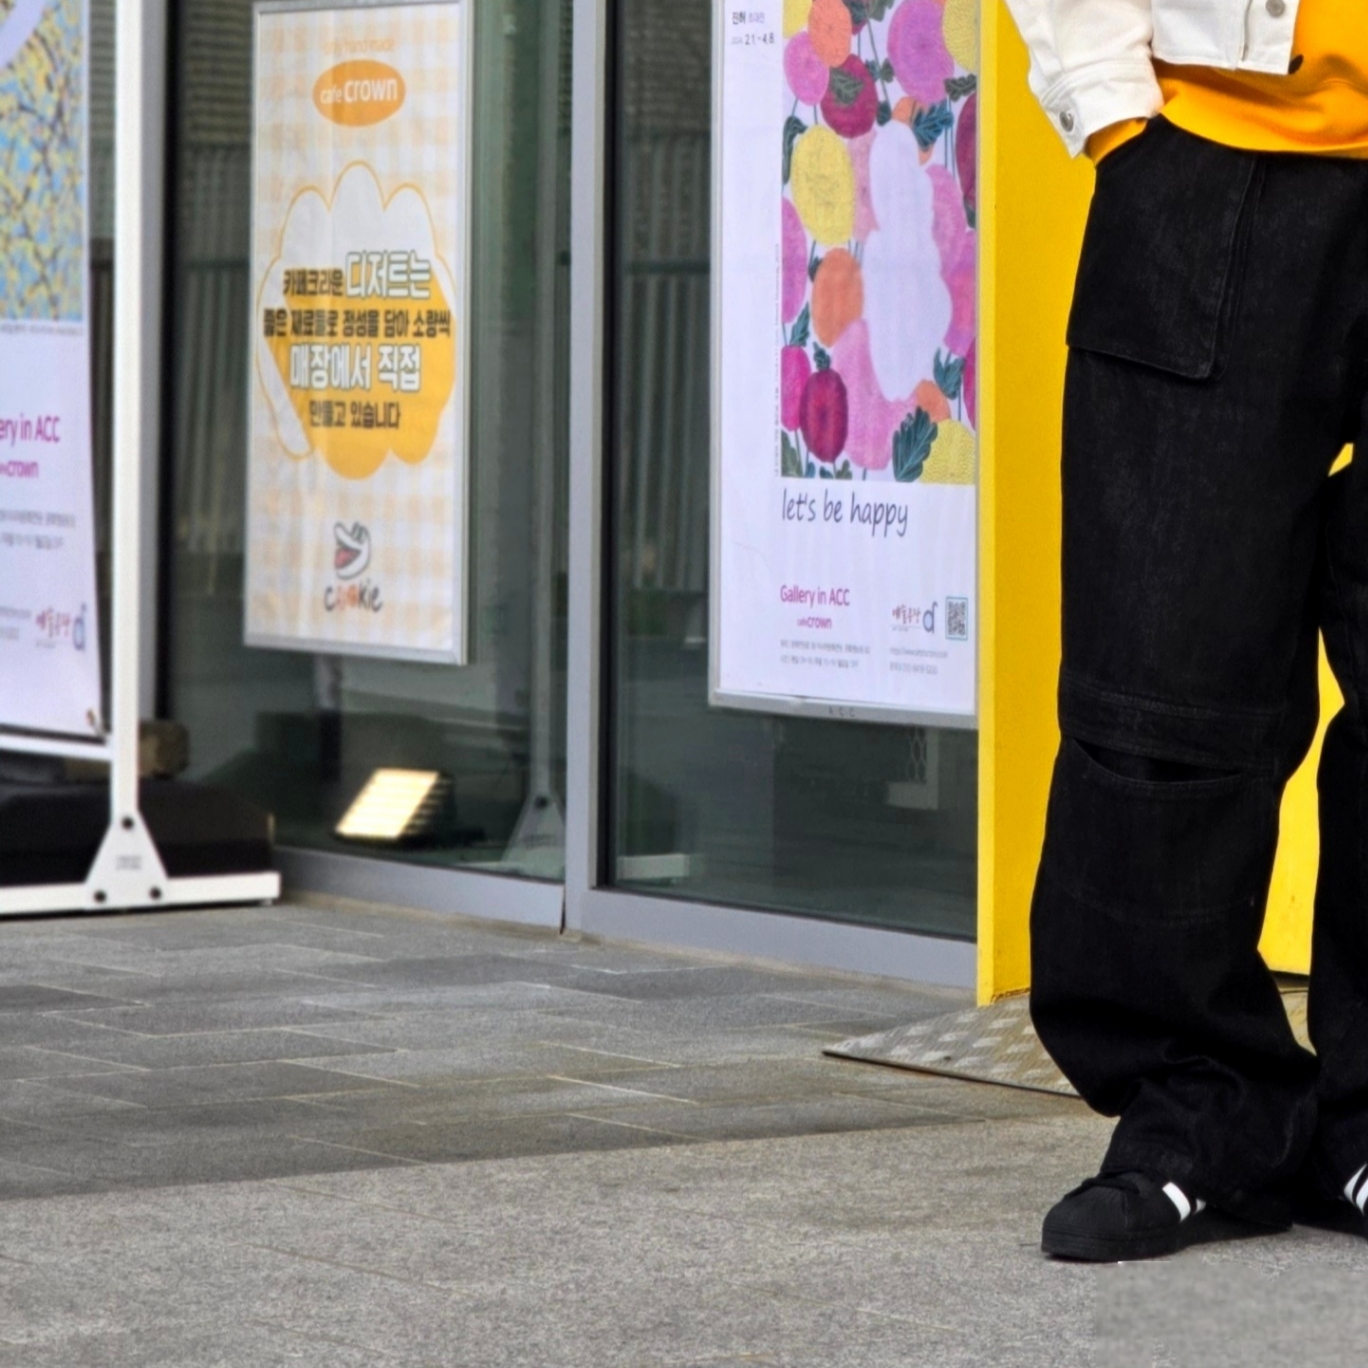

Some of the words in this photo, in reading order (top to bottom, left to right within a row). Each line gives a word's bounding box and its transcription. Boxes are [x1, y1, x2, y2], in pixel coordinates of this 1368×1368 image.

[345, 249, 432, 299] 디저트는
[290, 343, 371, 391] 매장에서
[377, 343, 421, 393] 직접
[20, 413, 33, 441] in
[35, 416, 60, 443] ACC
[350, 402, 401, 429] 있습니다
[782, 488, 816, 522] let's
[823, 489, 843, 523] be
[850, 492, 908, 537] happy
[780, 585, 815, 608] Gallery
[817, 587, 827, 604] in
[829, 588, 850, 606] ACC
